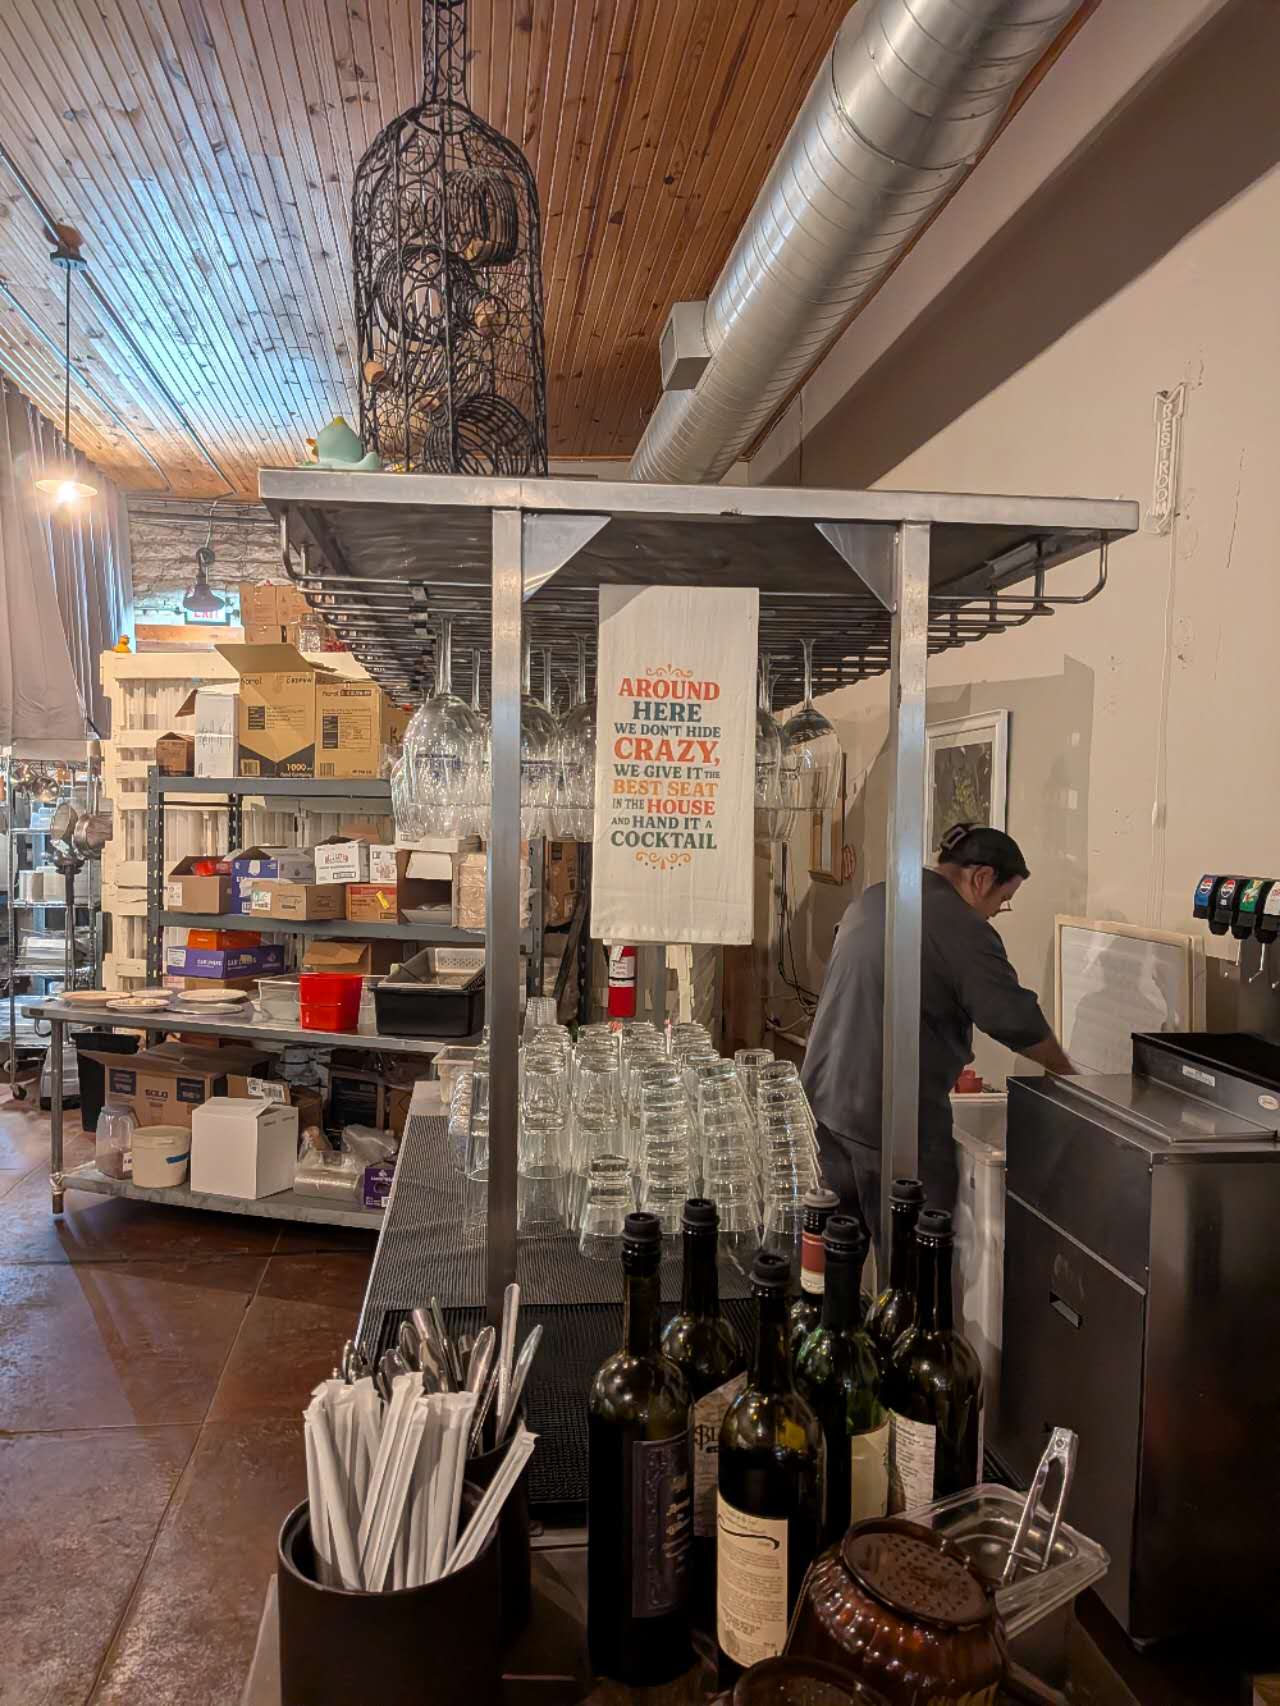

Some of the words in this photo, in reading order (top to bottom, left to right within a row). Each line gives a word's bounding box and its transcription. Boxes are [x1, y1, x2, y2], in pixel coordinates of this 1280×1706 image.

[618, 677, 721, 701] AROUND
[632, 700, 702, 722] HERE
[614, 722, 637, 734] WE
[640, 724, 682, 736] DON'T
[686, 726, 721, 738] HIDE
[614, 736, 721, 767] CRAZY,
[613, 763, 640, 778] WE
[644, 765, 682, 779] GIVE
[687, 767, 703, 780] IT
[703, 771, 721, 779] THE
[613, 779, 662, 796] BEST
[667, 781, 719, 798] SEAT
[612, 798, 623, 809] IN
[624, 798, 645, 810] THE
[647, 799, 716, 816] HOUSE
[611, 816, 631, 826] AND
[632, 815, 679, 829] HAND
[684, 817, 701, 830] IT
[704, 819, 713, 829] A
[610, 830, 718, 850] COCKTAIL
